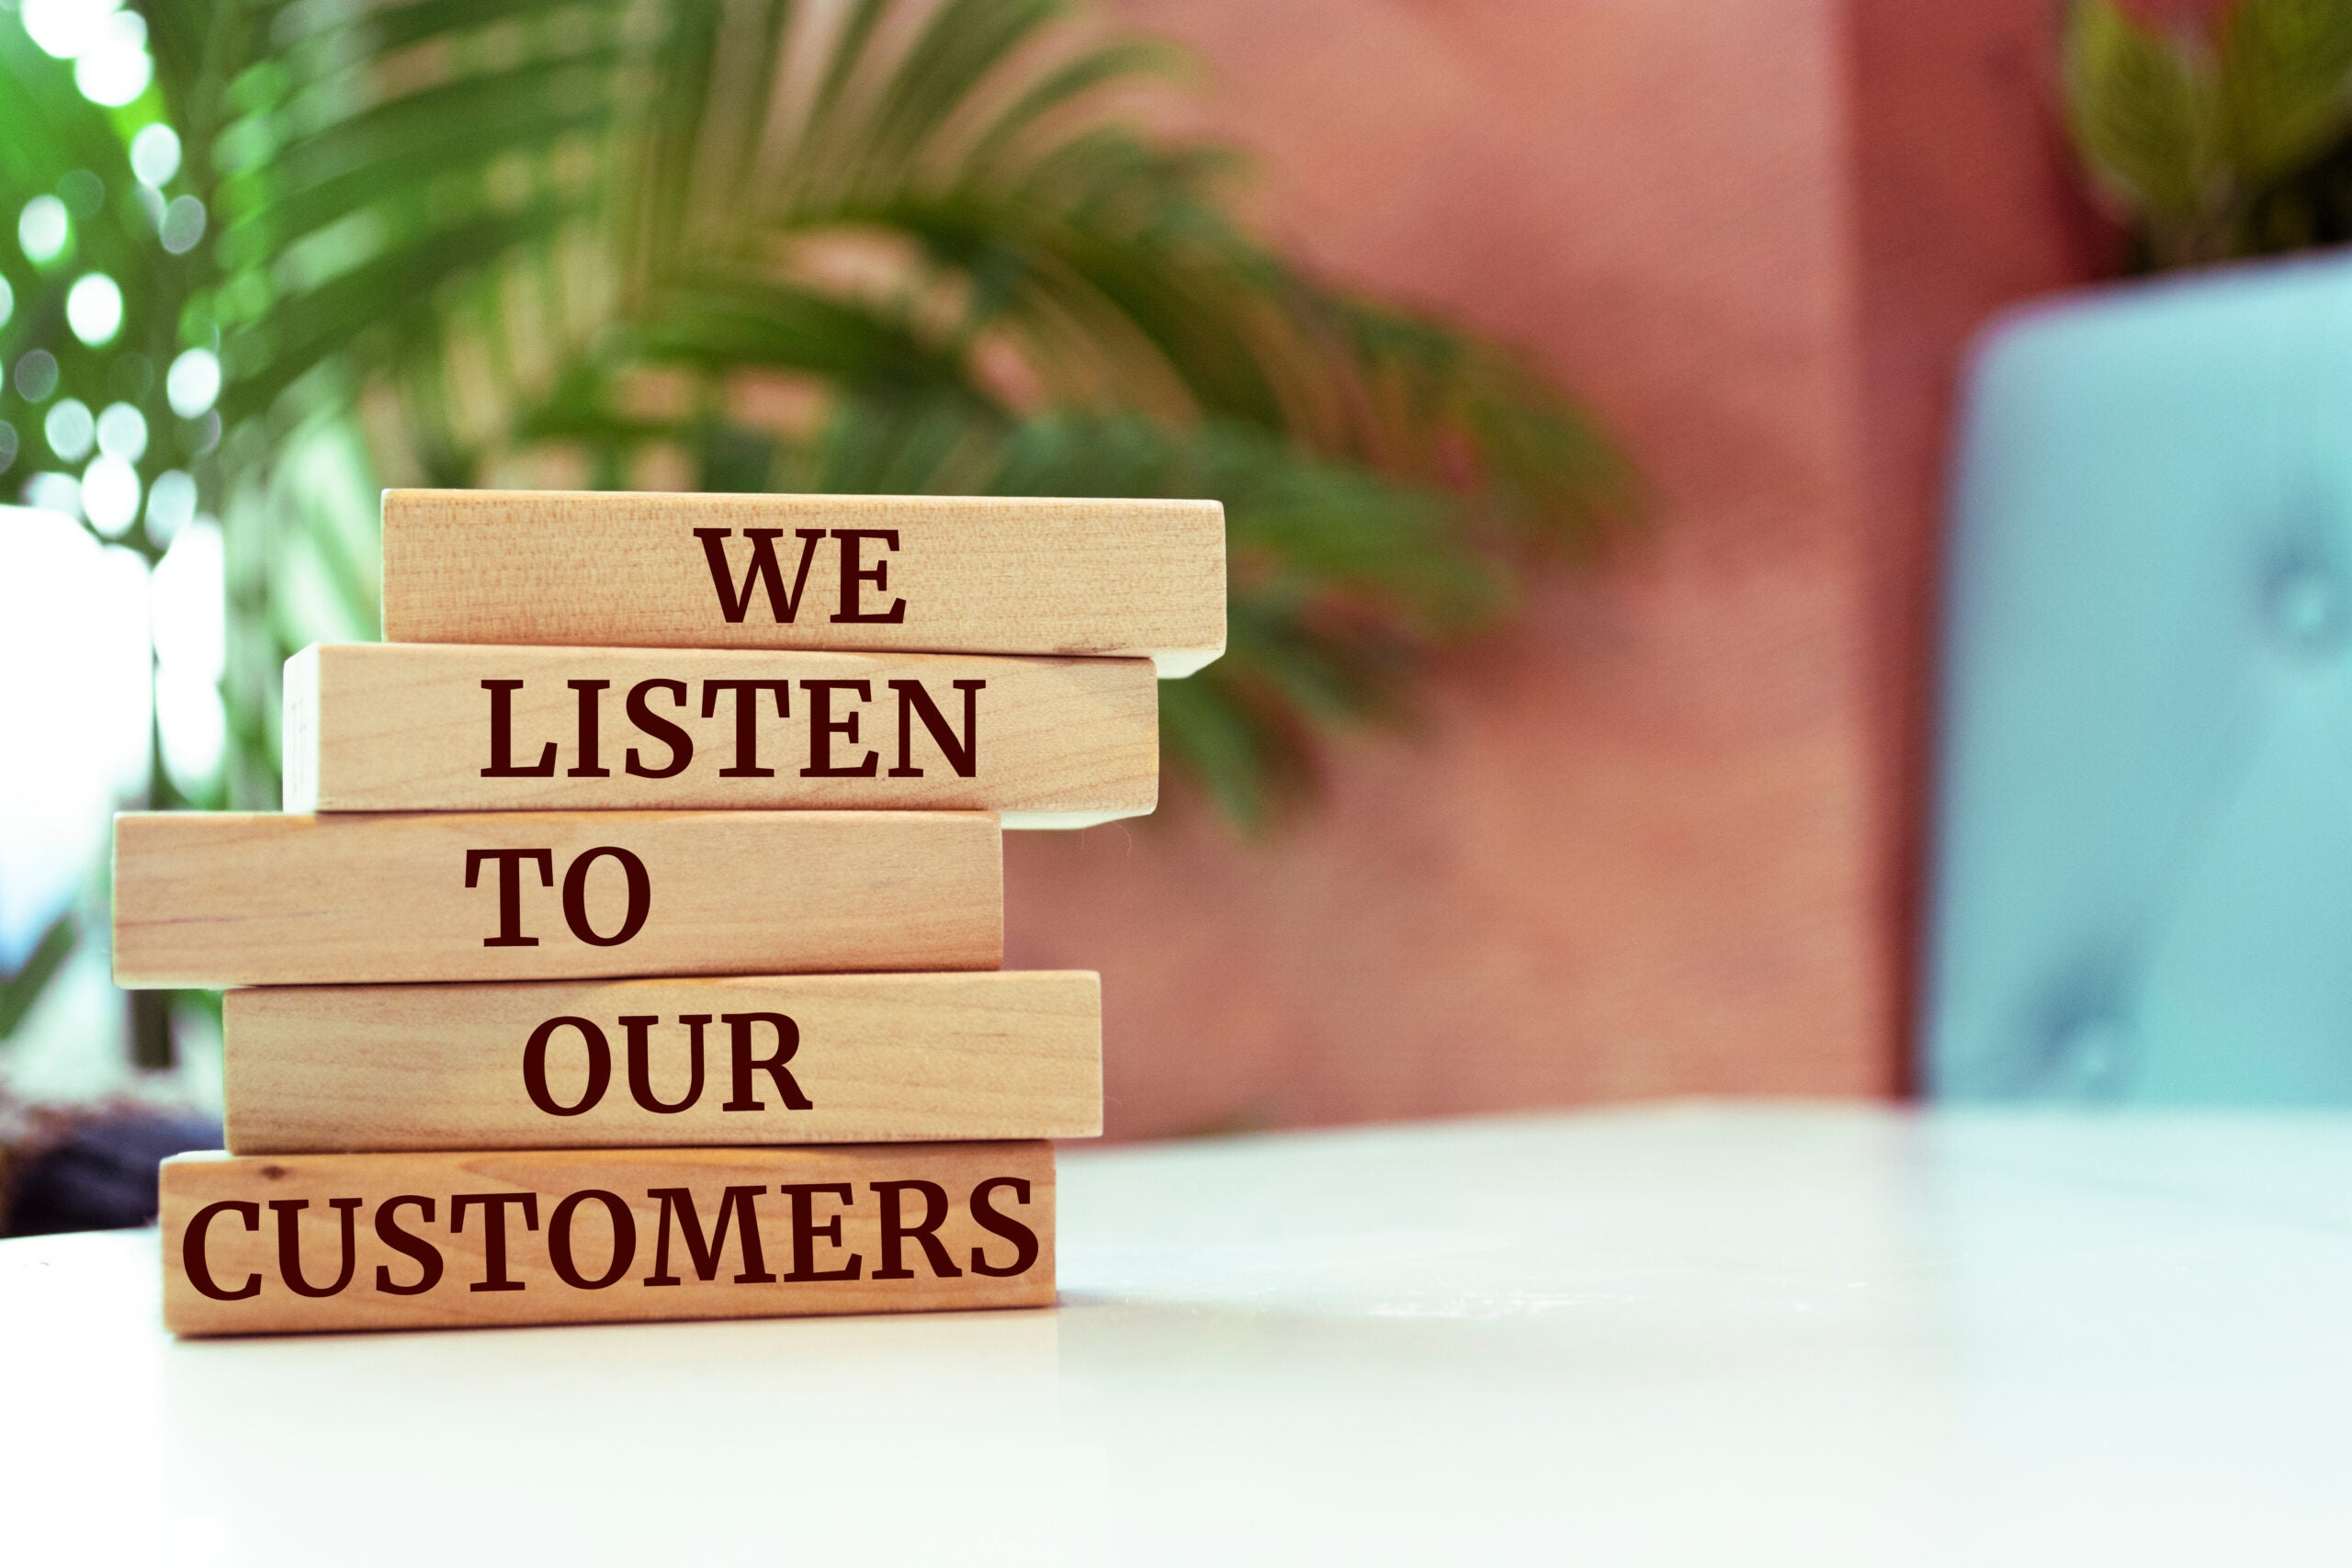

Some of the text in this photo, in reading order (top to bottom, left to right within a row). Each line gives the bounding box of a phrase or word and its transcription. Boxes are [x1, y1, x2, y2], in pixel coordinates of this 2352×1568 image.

[694, 528, 906, 623] WE
[481, 679, 986, 778] LISTEN
[466, 847, 650, 946] TO
[524, 1012, 812, 1116] OUR
[183, 1177, 1040, 1301] CUSTOMERS
